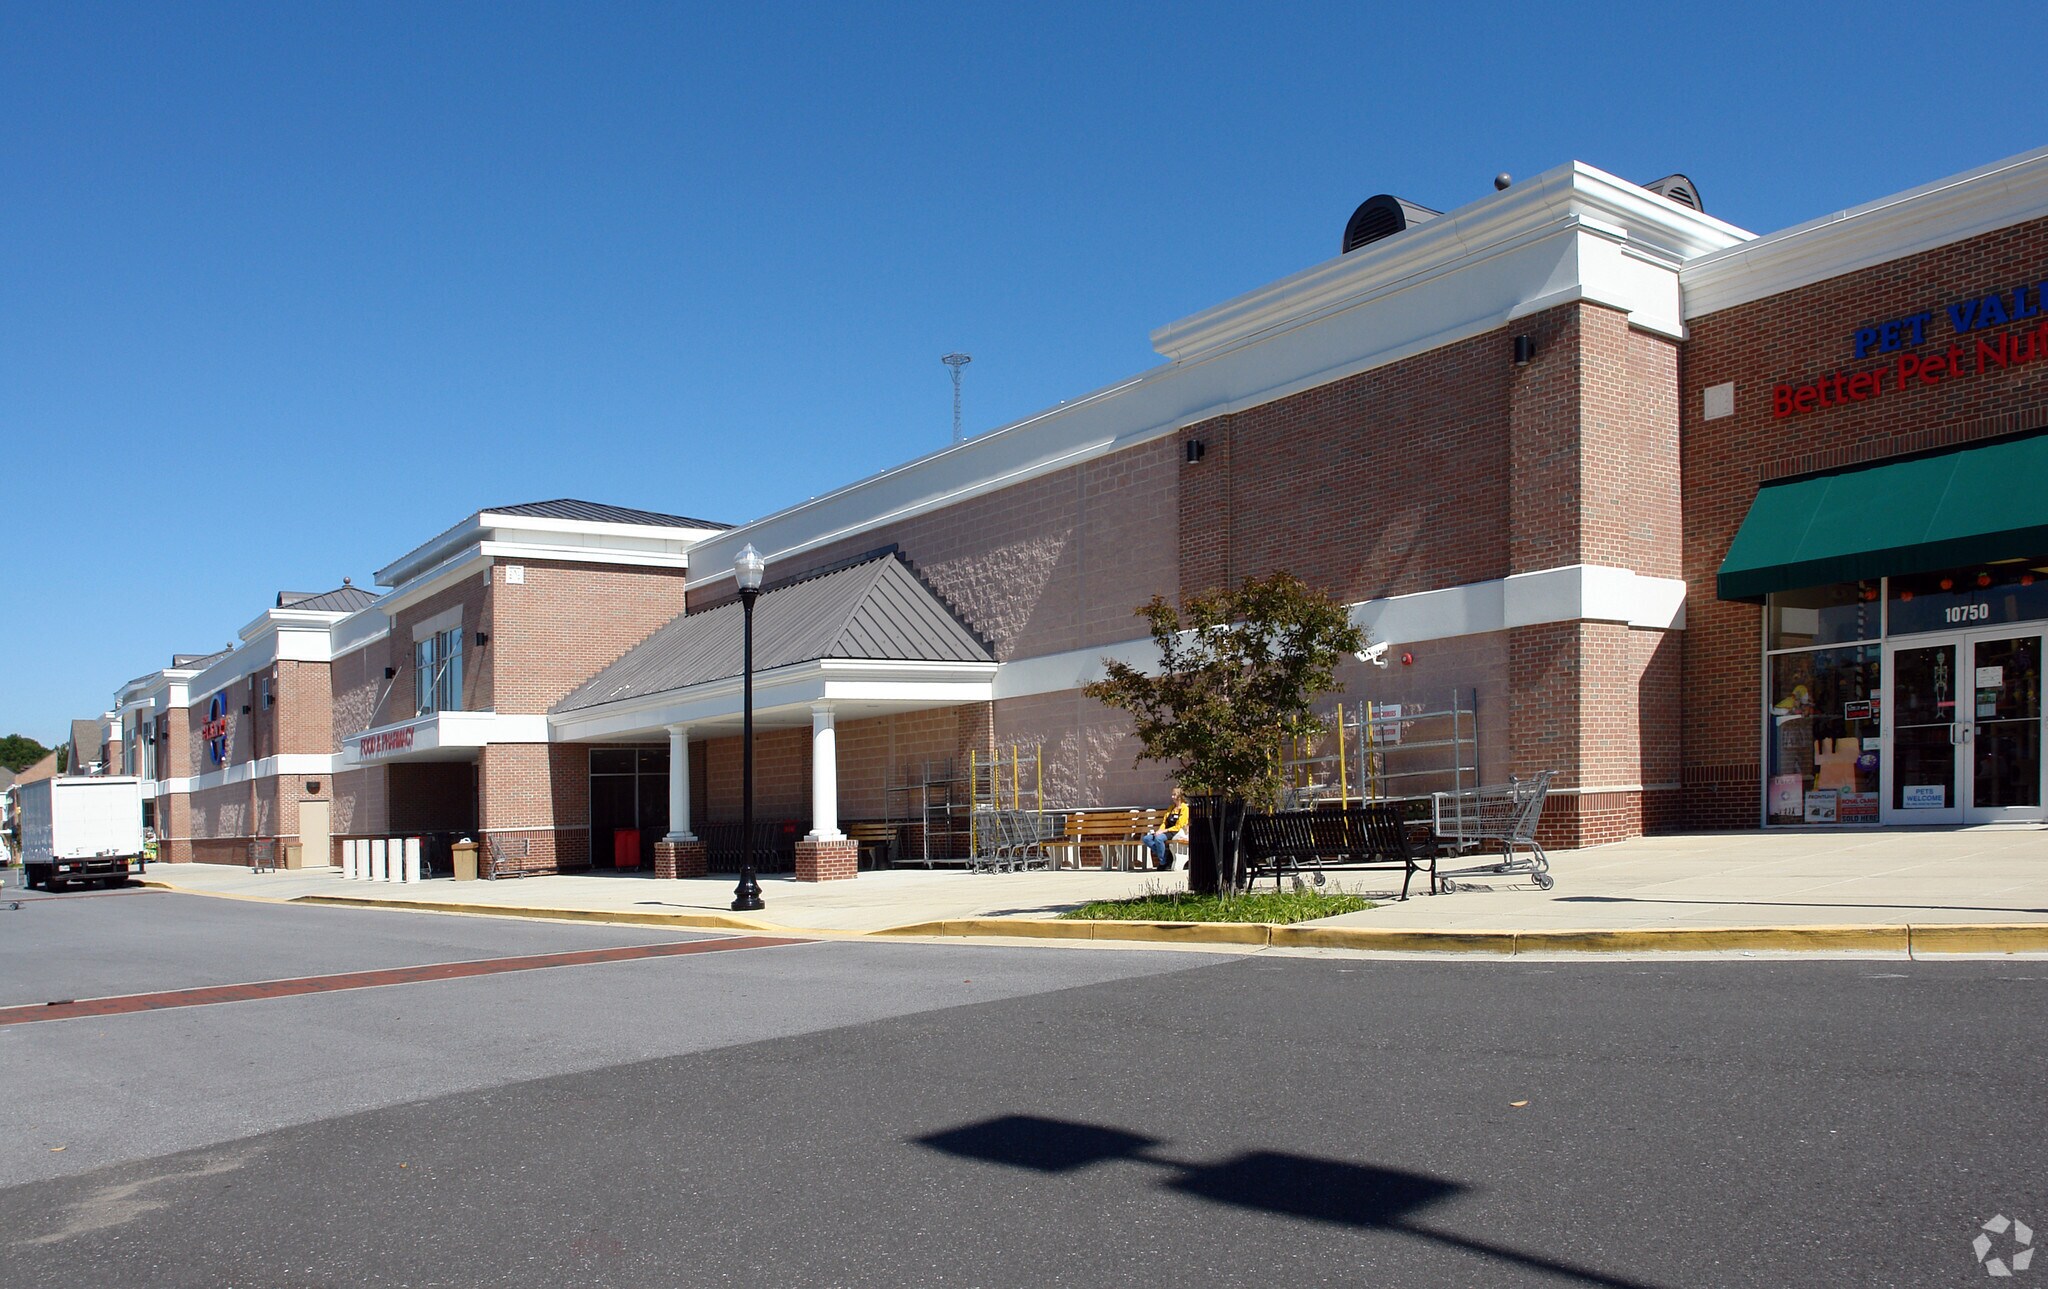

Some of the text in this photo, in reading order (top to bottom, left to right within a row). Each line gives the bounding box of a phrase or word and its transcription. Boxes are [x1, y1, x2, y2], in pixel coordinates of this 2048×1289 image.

[1853, 313, 1931, 359] PET
[1773, 366, 1889, 418] Better
[1897, 343, 1965, 391] Pet
[1945, 603, 1989, 623] 10750
[360, 735, 376, 756] FOOD
[381, 726, 415, 752] PHARMACY
[1860, 814, 1878, 822] HERE
